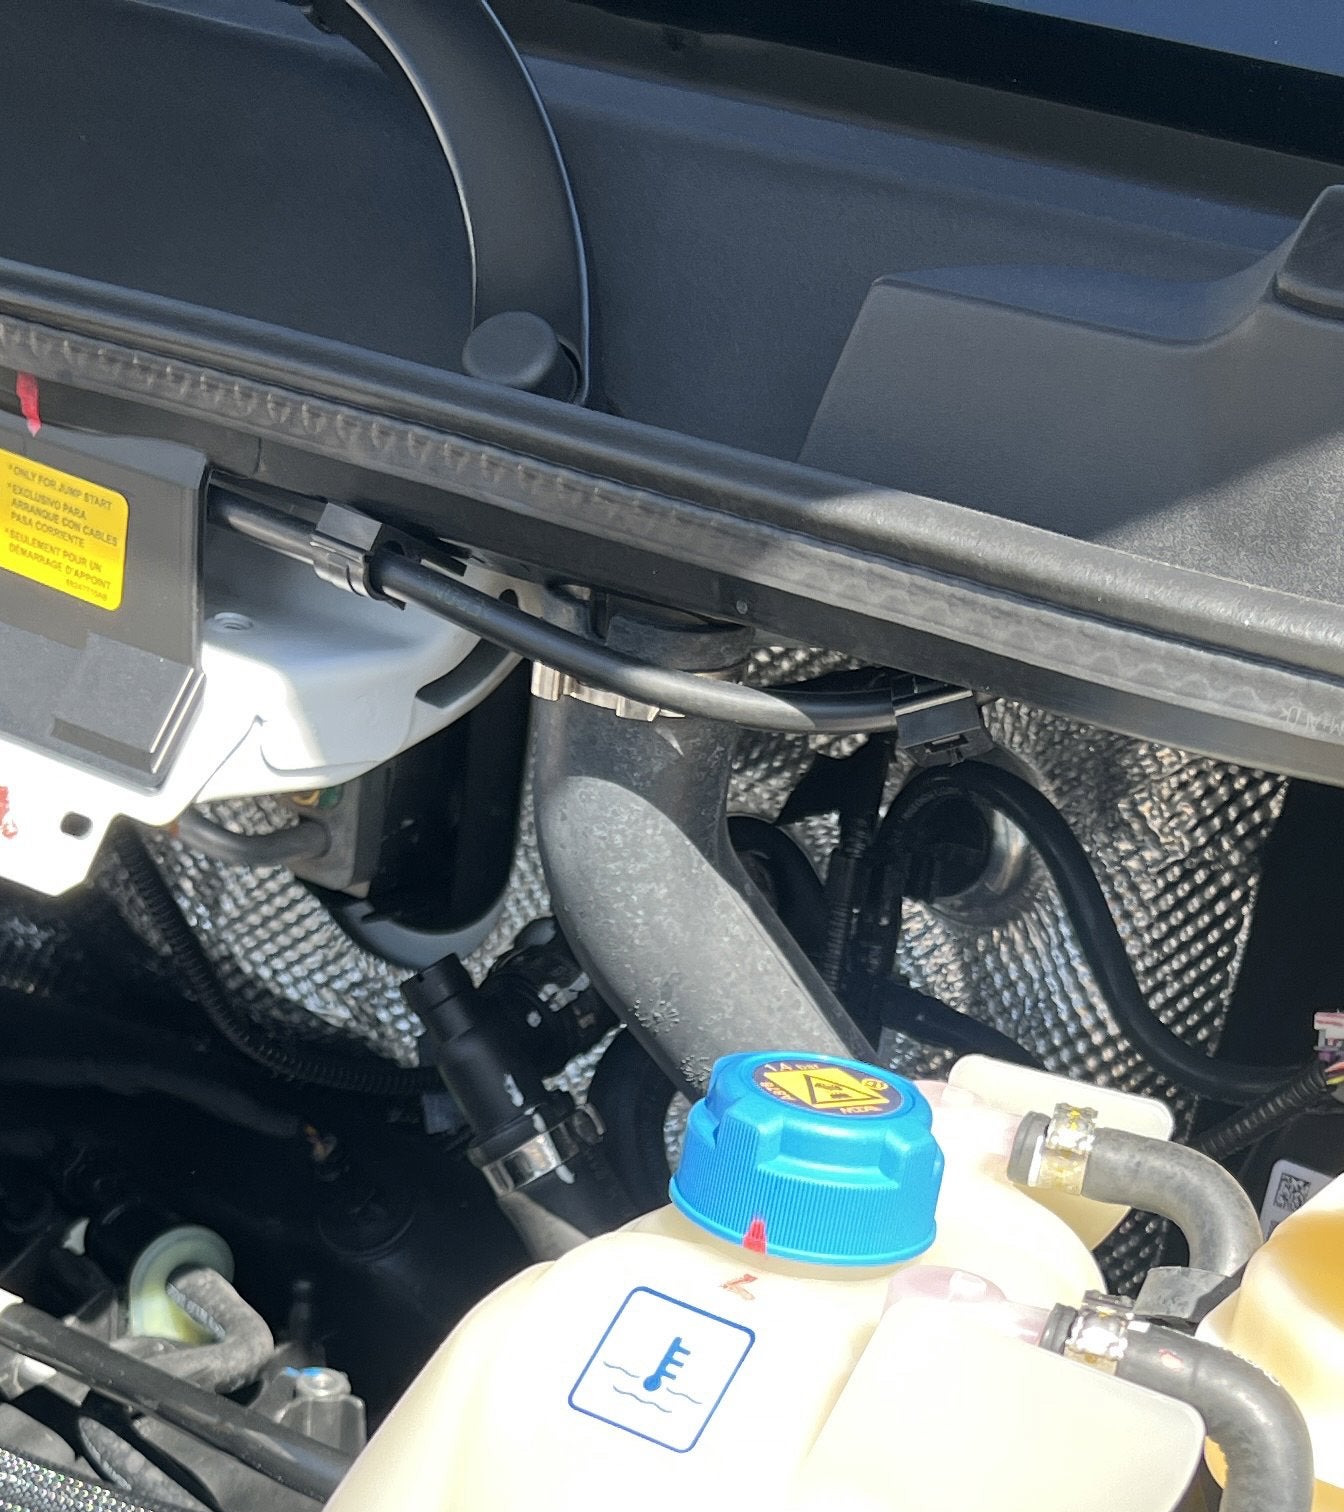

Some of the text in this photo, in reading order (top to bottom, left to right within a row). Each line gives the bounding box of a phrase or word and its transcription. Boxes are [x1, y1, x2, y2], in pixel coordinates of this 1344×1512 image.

[12, 484, 87, 519] EXCLUSIVO PARA
[84, 488, 112, 510] START
[11, 499, 60, 523] ARRANQUE
[82, 523, 118, 546] CABLES
[11, 512, 85, 548] PASA CORRIENTE
[11, 530, 62, 557] SEULEMENT
[63, 548, 88, 566] POUR
